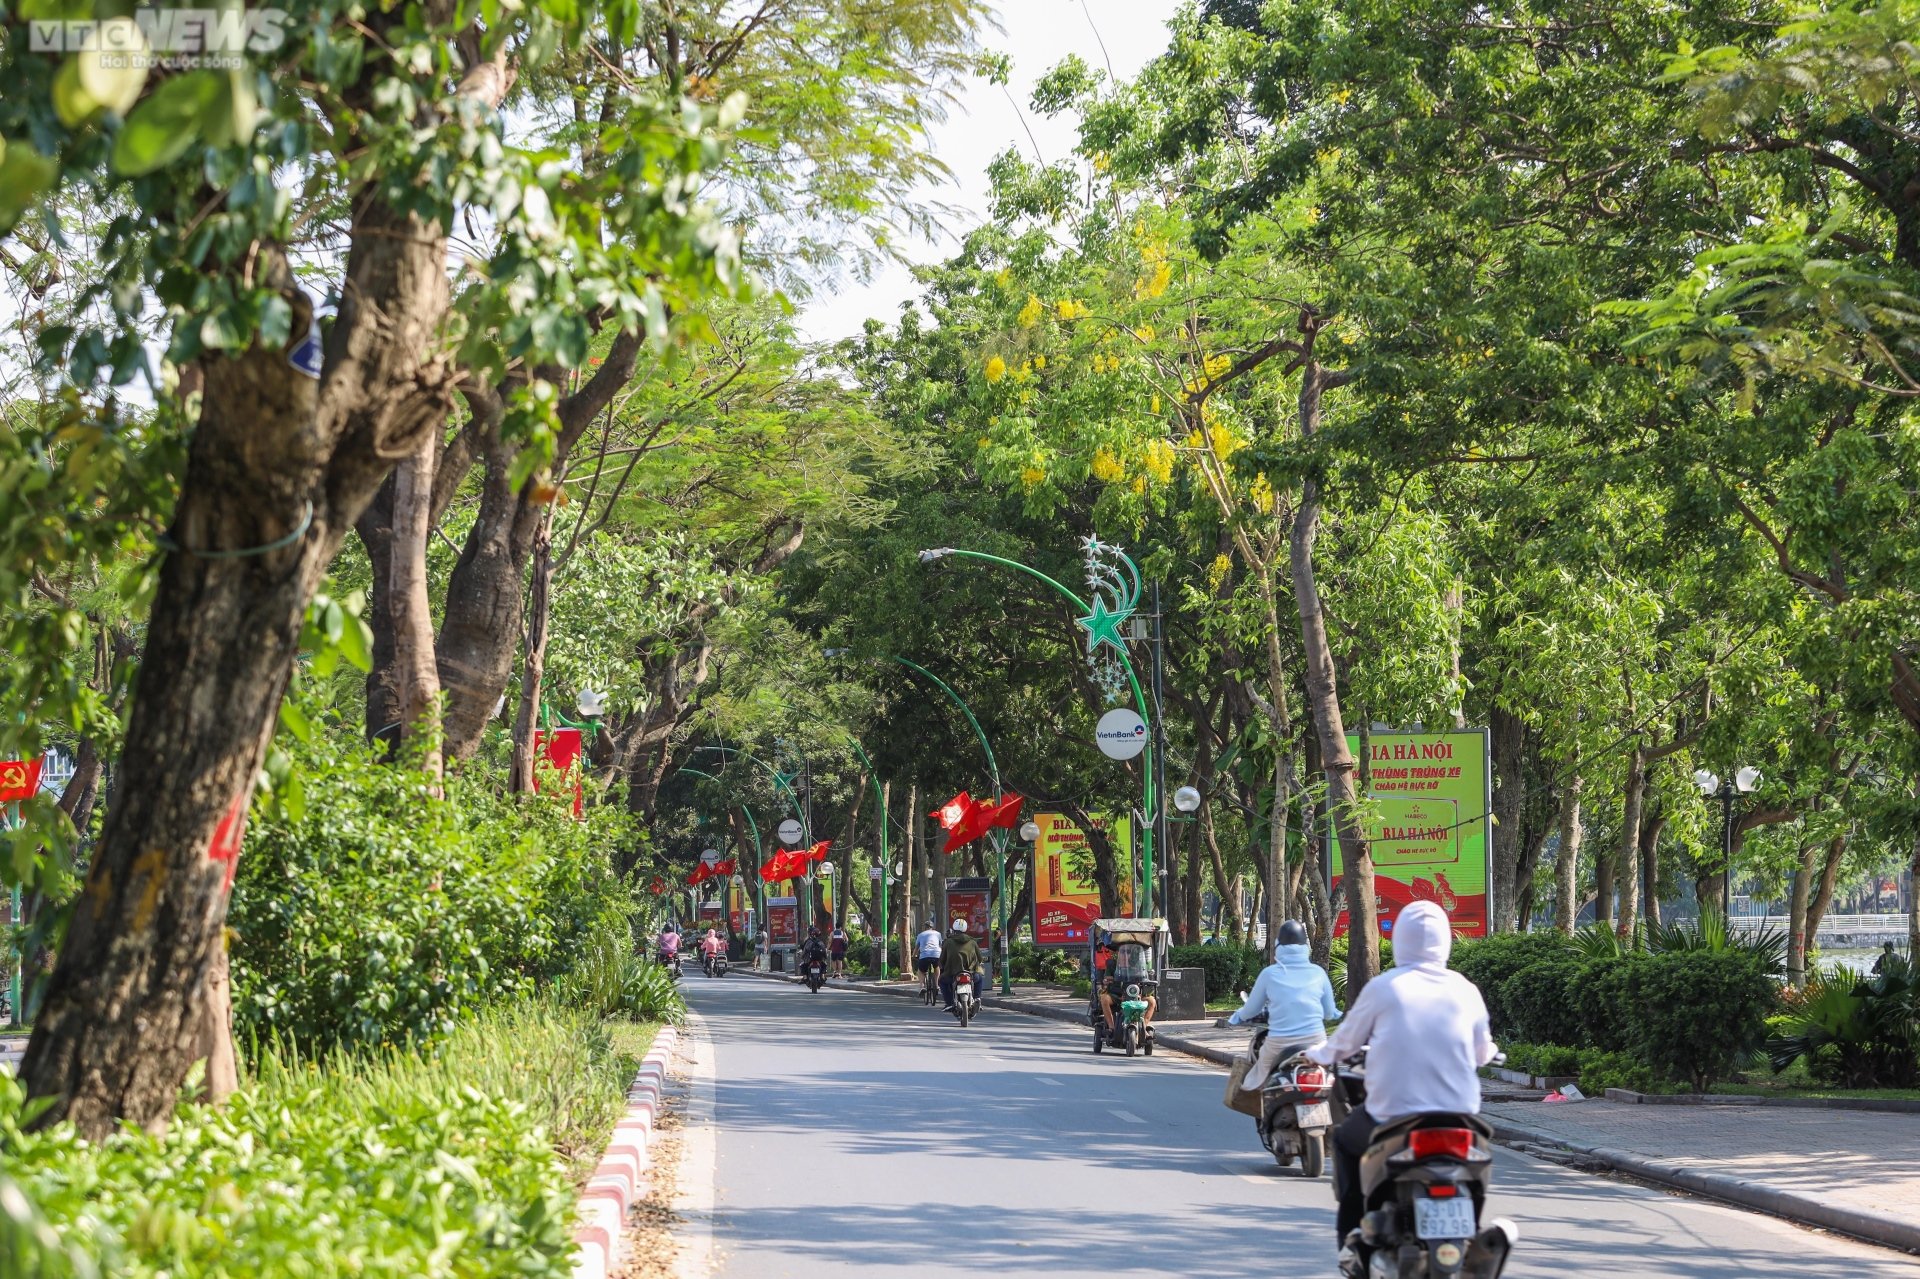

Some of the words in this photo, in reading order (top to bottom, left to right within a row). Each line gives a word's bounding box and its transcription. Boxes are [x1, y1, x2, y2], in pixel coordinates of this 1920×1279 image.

[1097, 731, 1135, 739] VietinBank
[1393, 739, 1419, 760] HÀ
[1422, 739, 1453, 762] NỘI
[1447, 767, 1461, 777] XE
[1383, 827, 1405, 840] BIA
[1408, 823, 1425, 840] HÀ
[1427, 824, 1448, 842] NỘI
